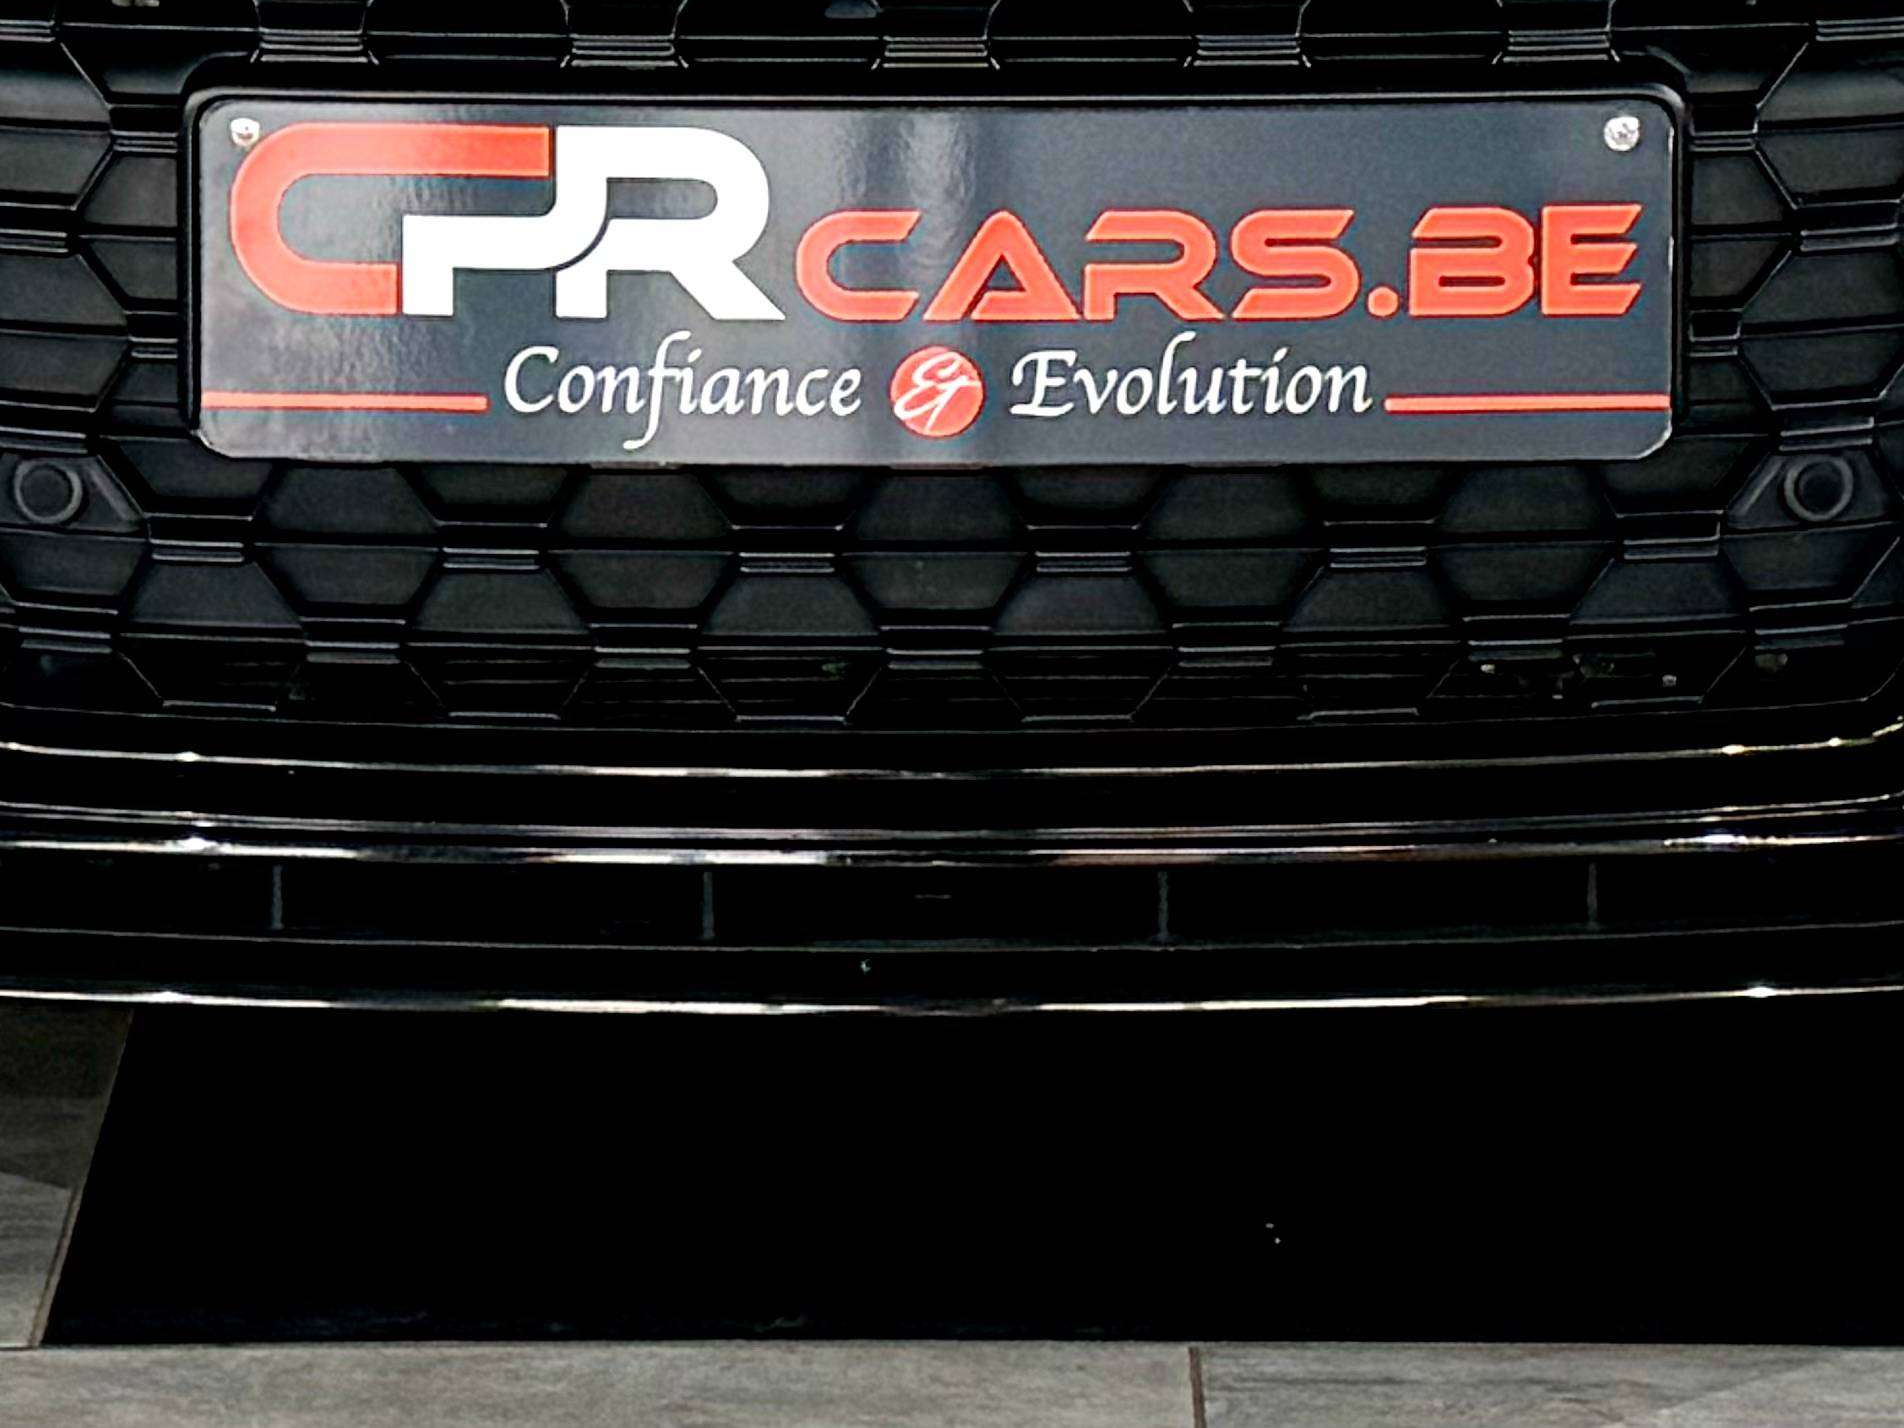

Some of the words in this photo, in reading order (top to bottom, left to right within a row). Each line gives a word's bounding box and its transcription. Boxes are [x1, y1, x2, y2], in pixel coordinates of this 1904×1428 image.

[230, 123, 786, 320] CPR
[795, 204, 1643, 323] CARS.BE
[503, 330, 862, 450] Confiance
[1009, 331, 1374, 418] Evolution
